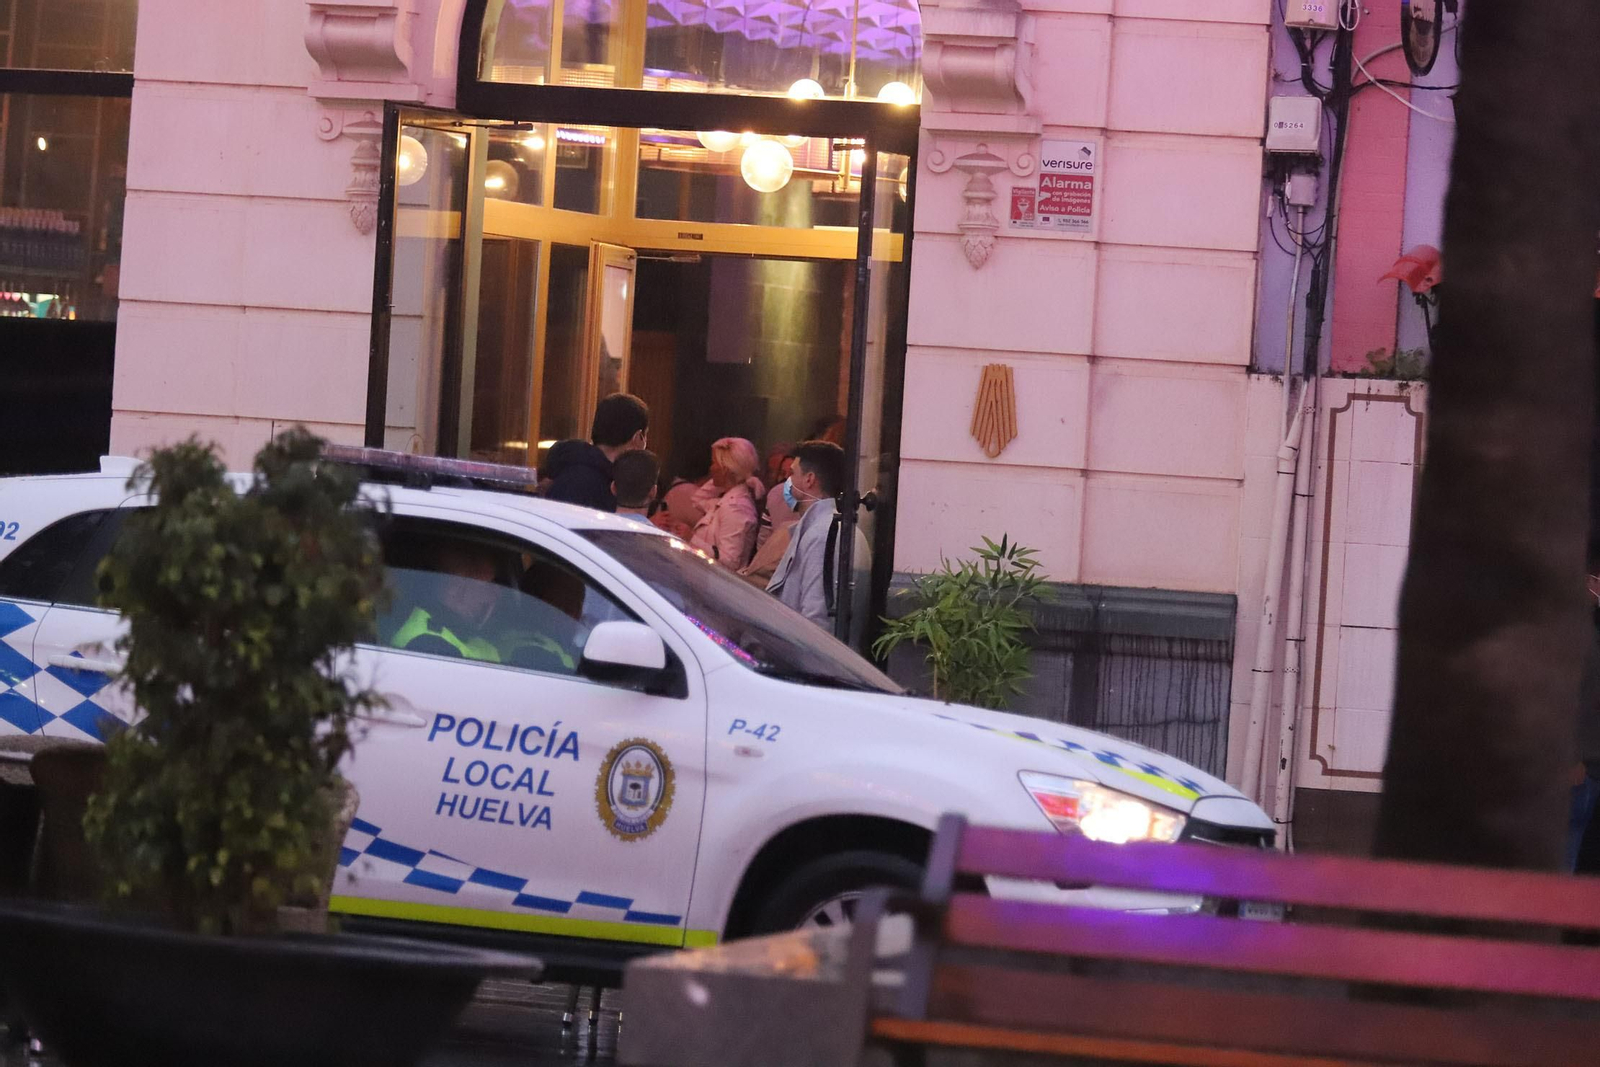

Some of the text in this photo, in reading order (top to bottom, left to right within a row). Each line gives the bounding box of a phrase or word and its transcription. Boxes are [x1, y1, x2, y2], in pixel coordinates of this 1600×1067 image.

[1302, 4, 1323, 12] 3336
[1273, 121, 1304, 129] 05264
[1042, 159, 1093, 170] verisure
[1041, 176, 1092, 190] Alarma
[1067, 206, 1091, 214] Policía
[427, 713, 580, 762] POLICÍA
[728, 719, 781, 742] P-42
[442, 757, 555, 797] LOCAL
[435, 792, 552, 831] HUELVA
